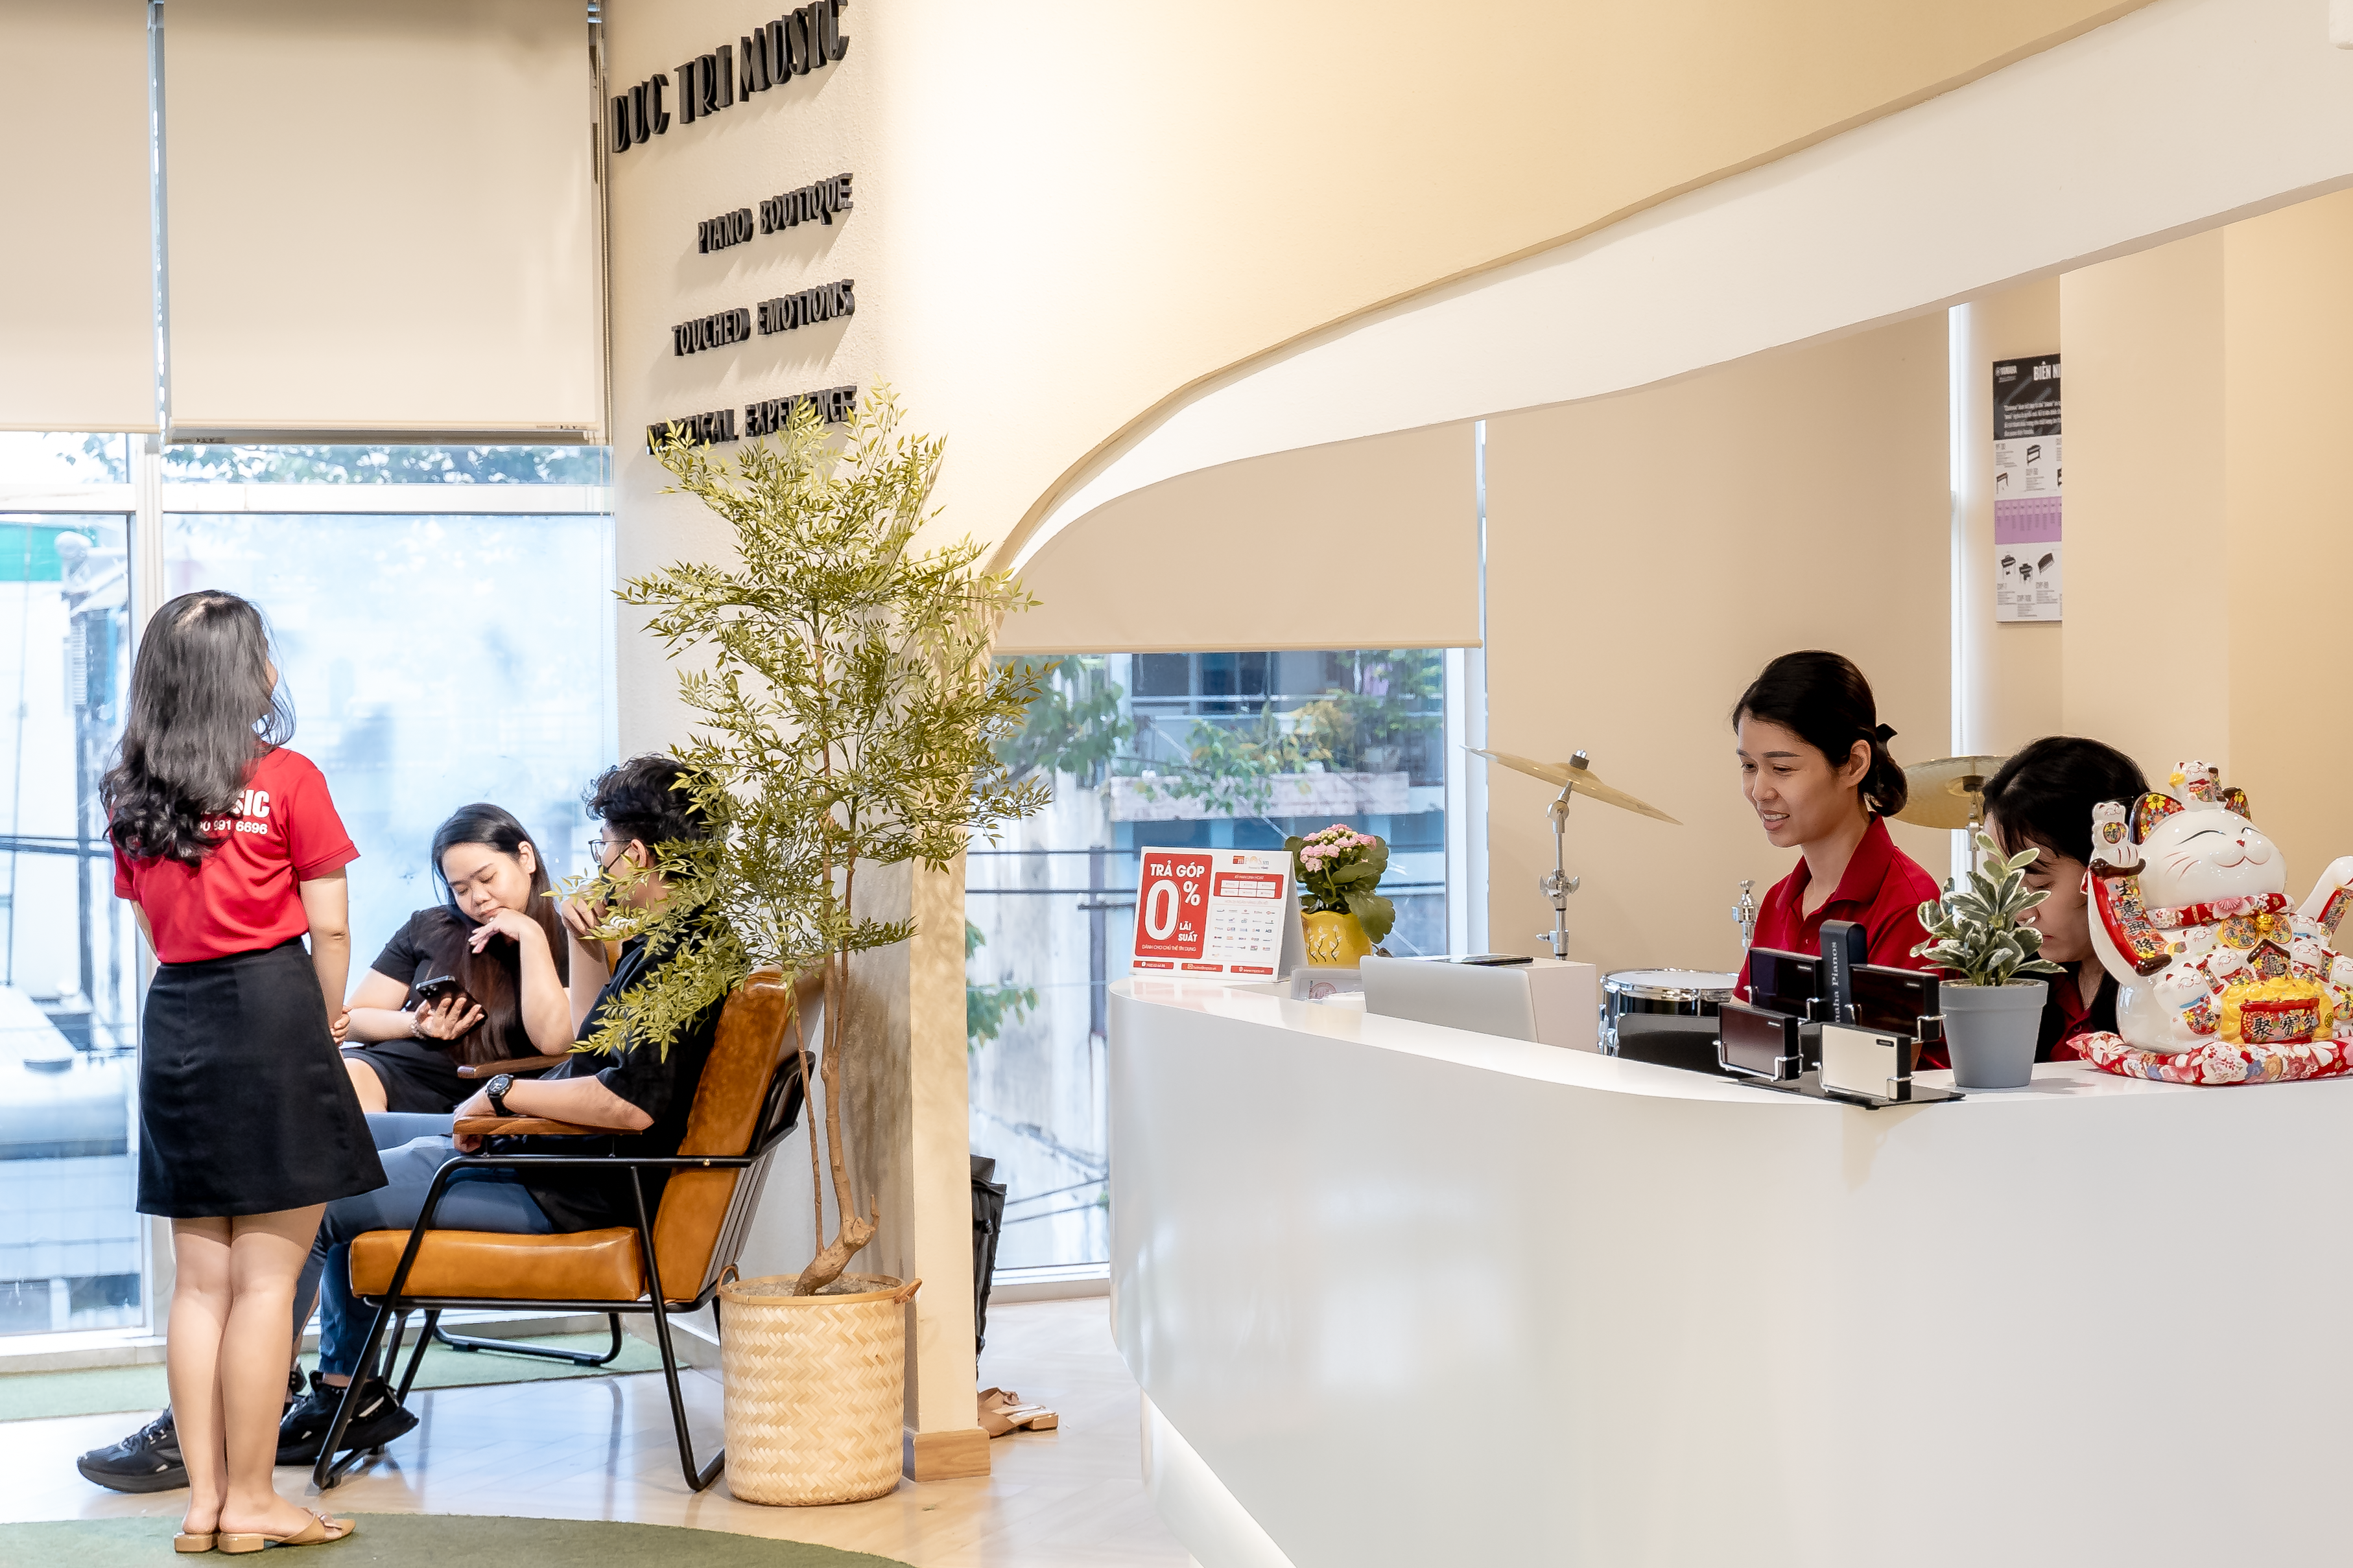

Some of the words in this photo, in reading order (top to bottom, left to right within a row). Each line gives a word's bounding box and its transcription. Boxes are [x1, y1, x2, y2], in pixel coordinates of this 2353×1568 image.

[611, 74, 670, 154] DUC
[674, 45, 734, 124] TRI
[739, 0, 849, 102] MUSIC
[698, 208, 753, 254] PIANO
[760, 173, 853, 234] BOUTIQUE
[672, 308, 751, 357] TOUCHED
[757, 279, 855, 335] EMOTIONS
[235, 821, 268, 835] 6696
[1150, 860, 1172, 876] TRẢ
[1176, 862, 1205, 878] GÓP
[1144, 880, 1181, 940] 0
[1183, 881, 1201, 906] %
[1179, 920, 1192, 931] LÃI
[1178, 931, 1198, 942] SUẤT
